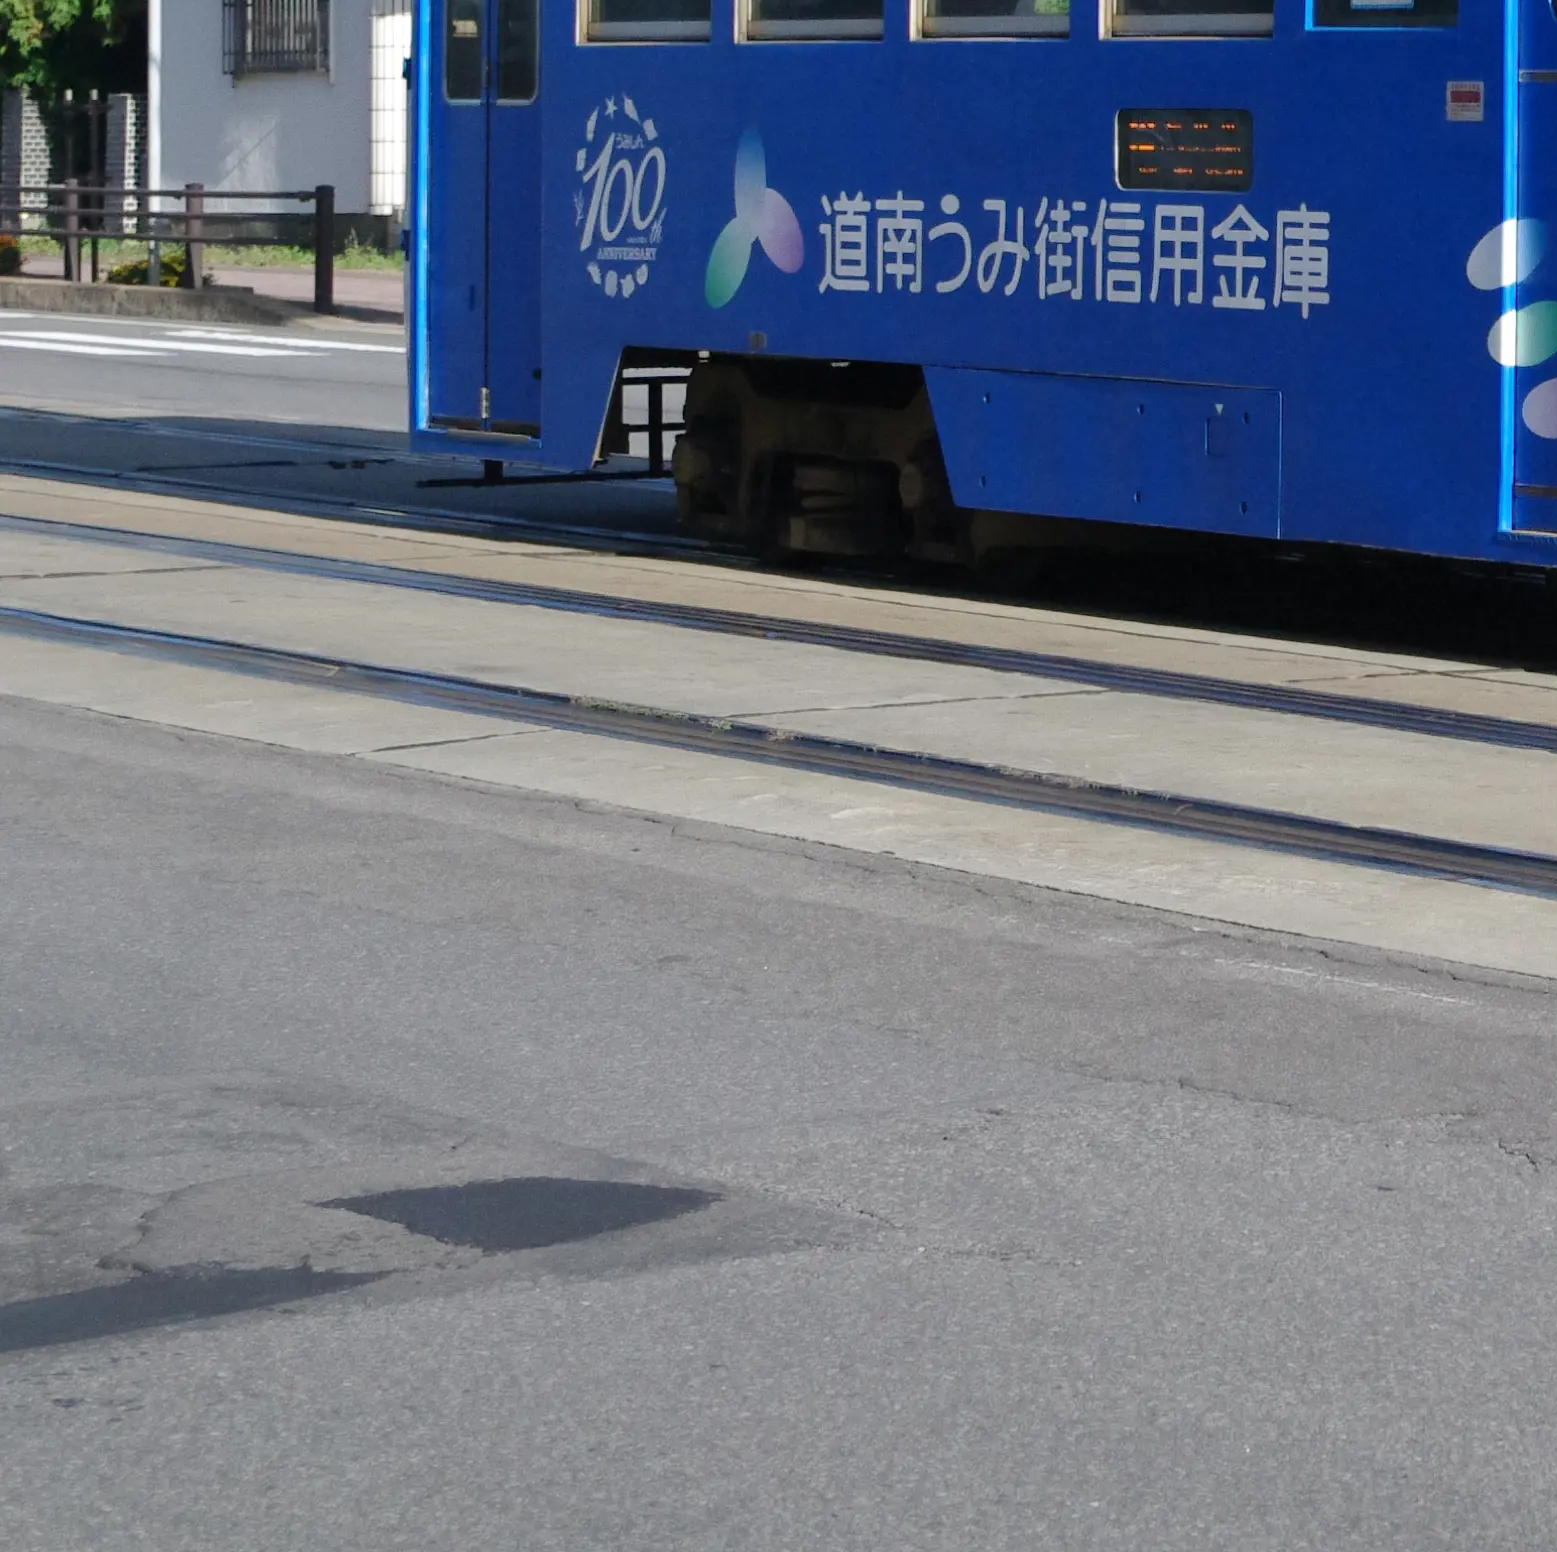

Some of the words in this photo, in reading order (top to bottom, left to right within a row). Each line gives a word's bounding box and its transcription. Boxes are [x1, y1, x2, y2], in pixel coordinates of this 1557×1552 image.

[597, 246, 657, 260] ANNIVERSARY
[818, 189, 1331, 320] 道南うみ街信用金庫
